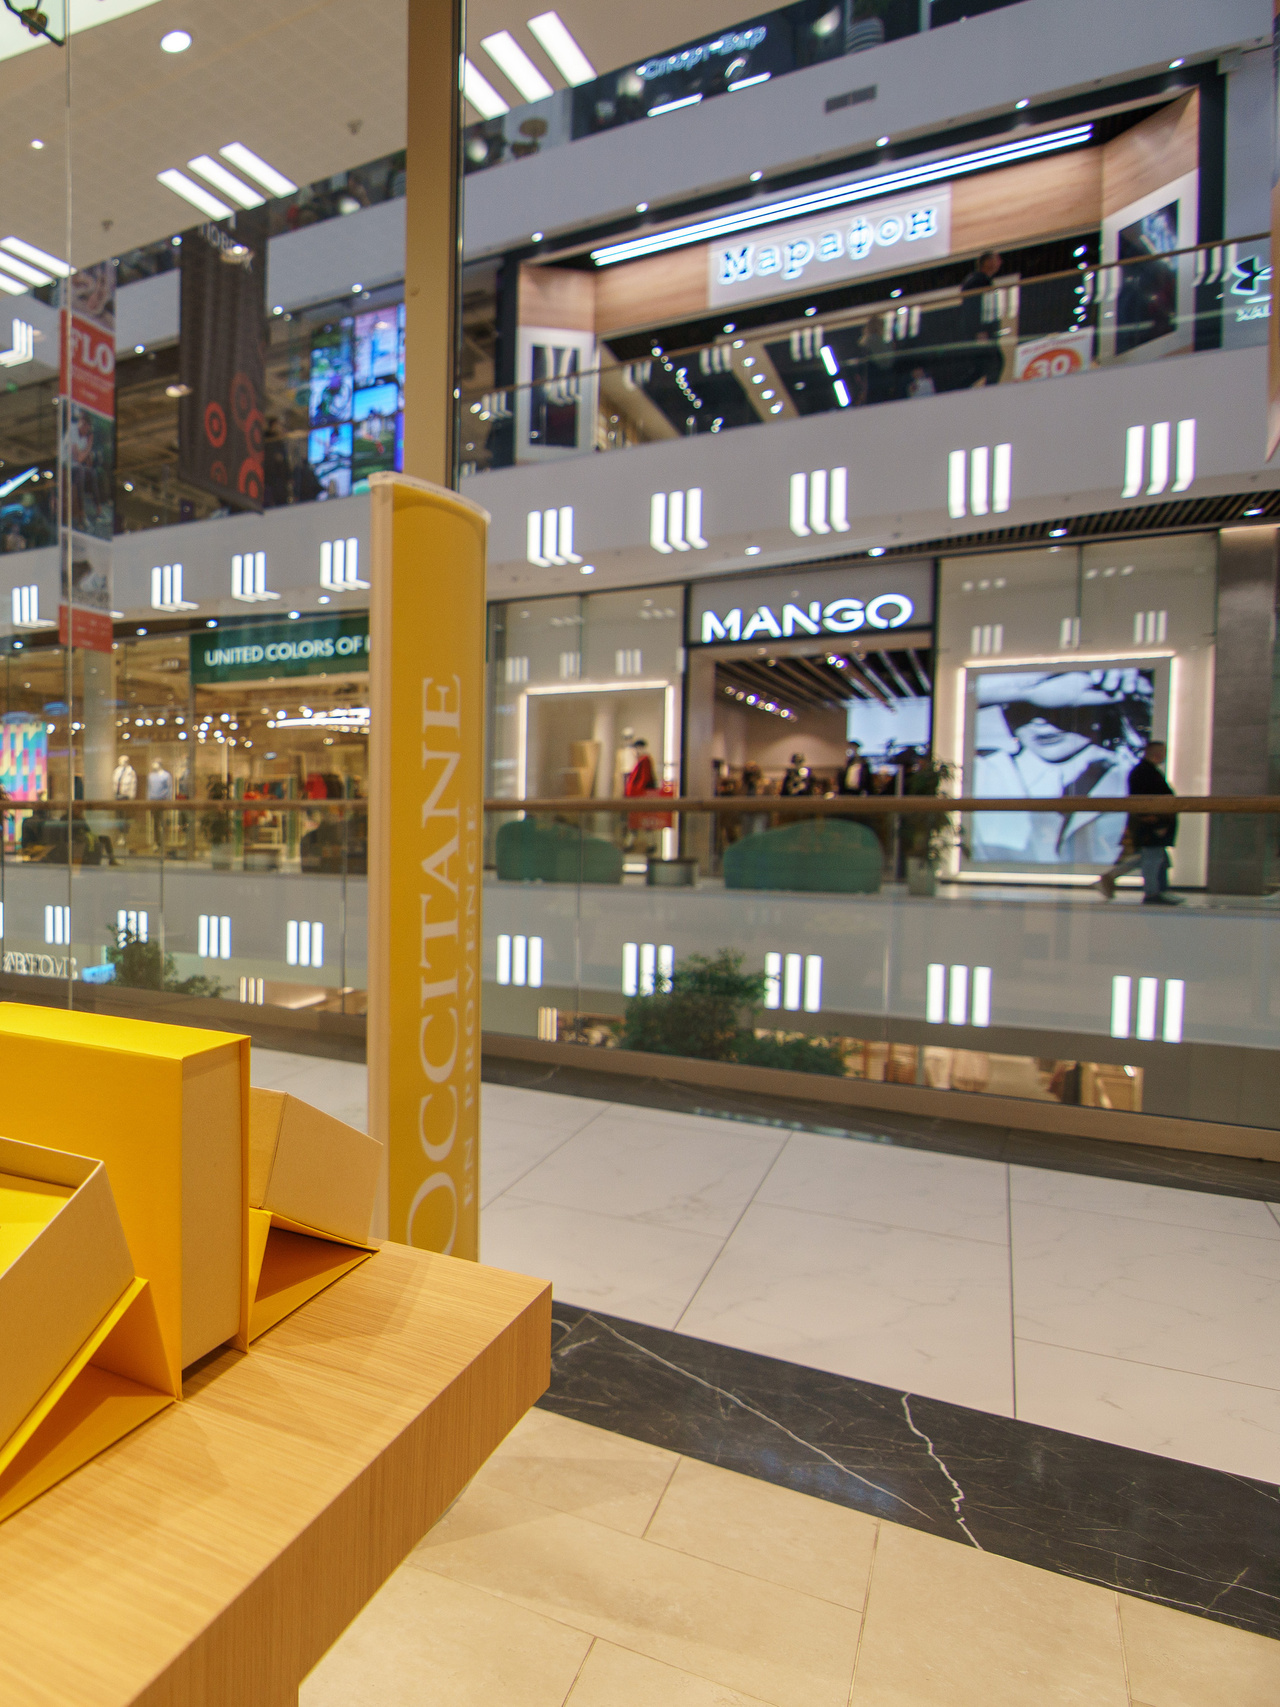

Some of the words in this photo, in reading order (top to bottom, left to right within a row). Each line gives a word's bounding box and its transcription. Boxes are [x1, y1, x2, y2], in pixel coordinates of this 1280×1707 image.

[718, 207, 938, 285] Марафон
[701, 593, 915, 643] MANGO
[204, 645, 264, 666] UNITED
[265, 638, 334, 661] COLORS
[335, 635, 363, 655] OF
